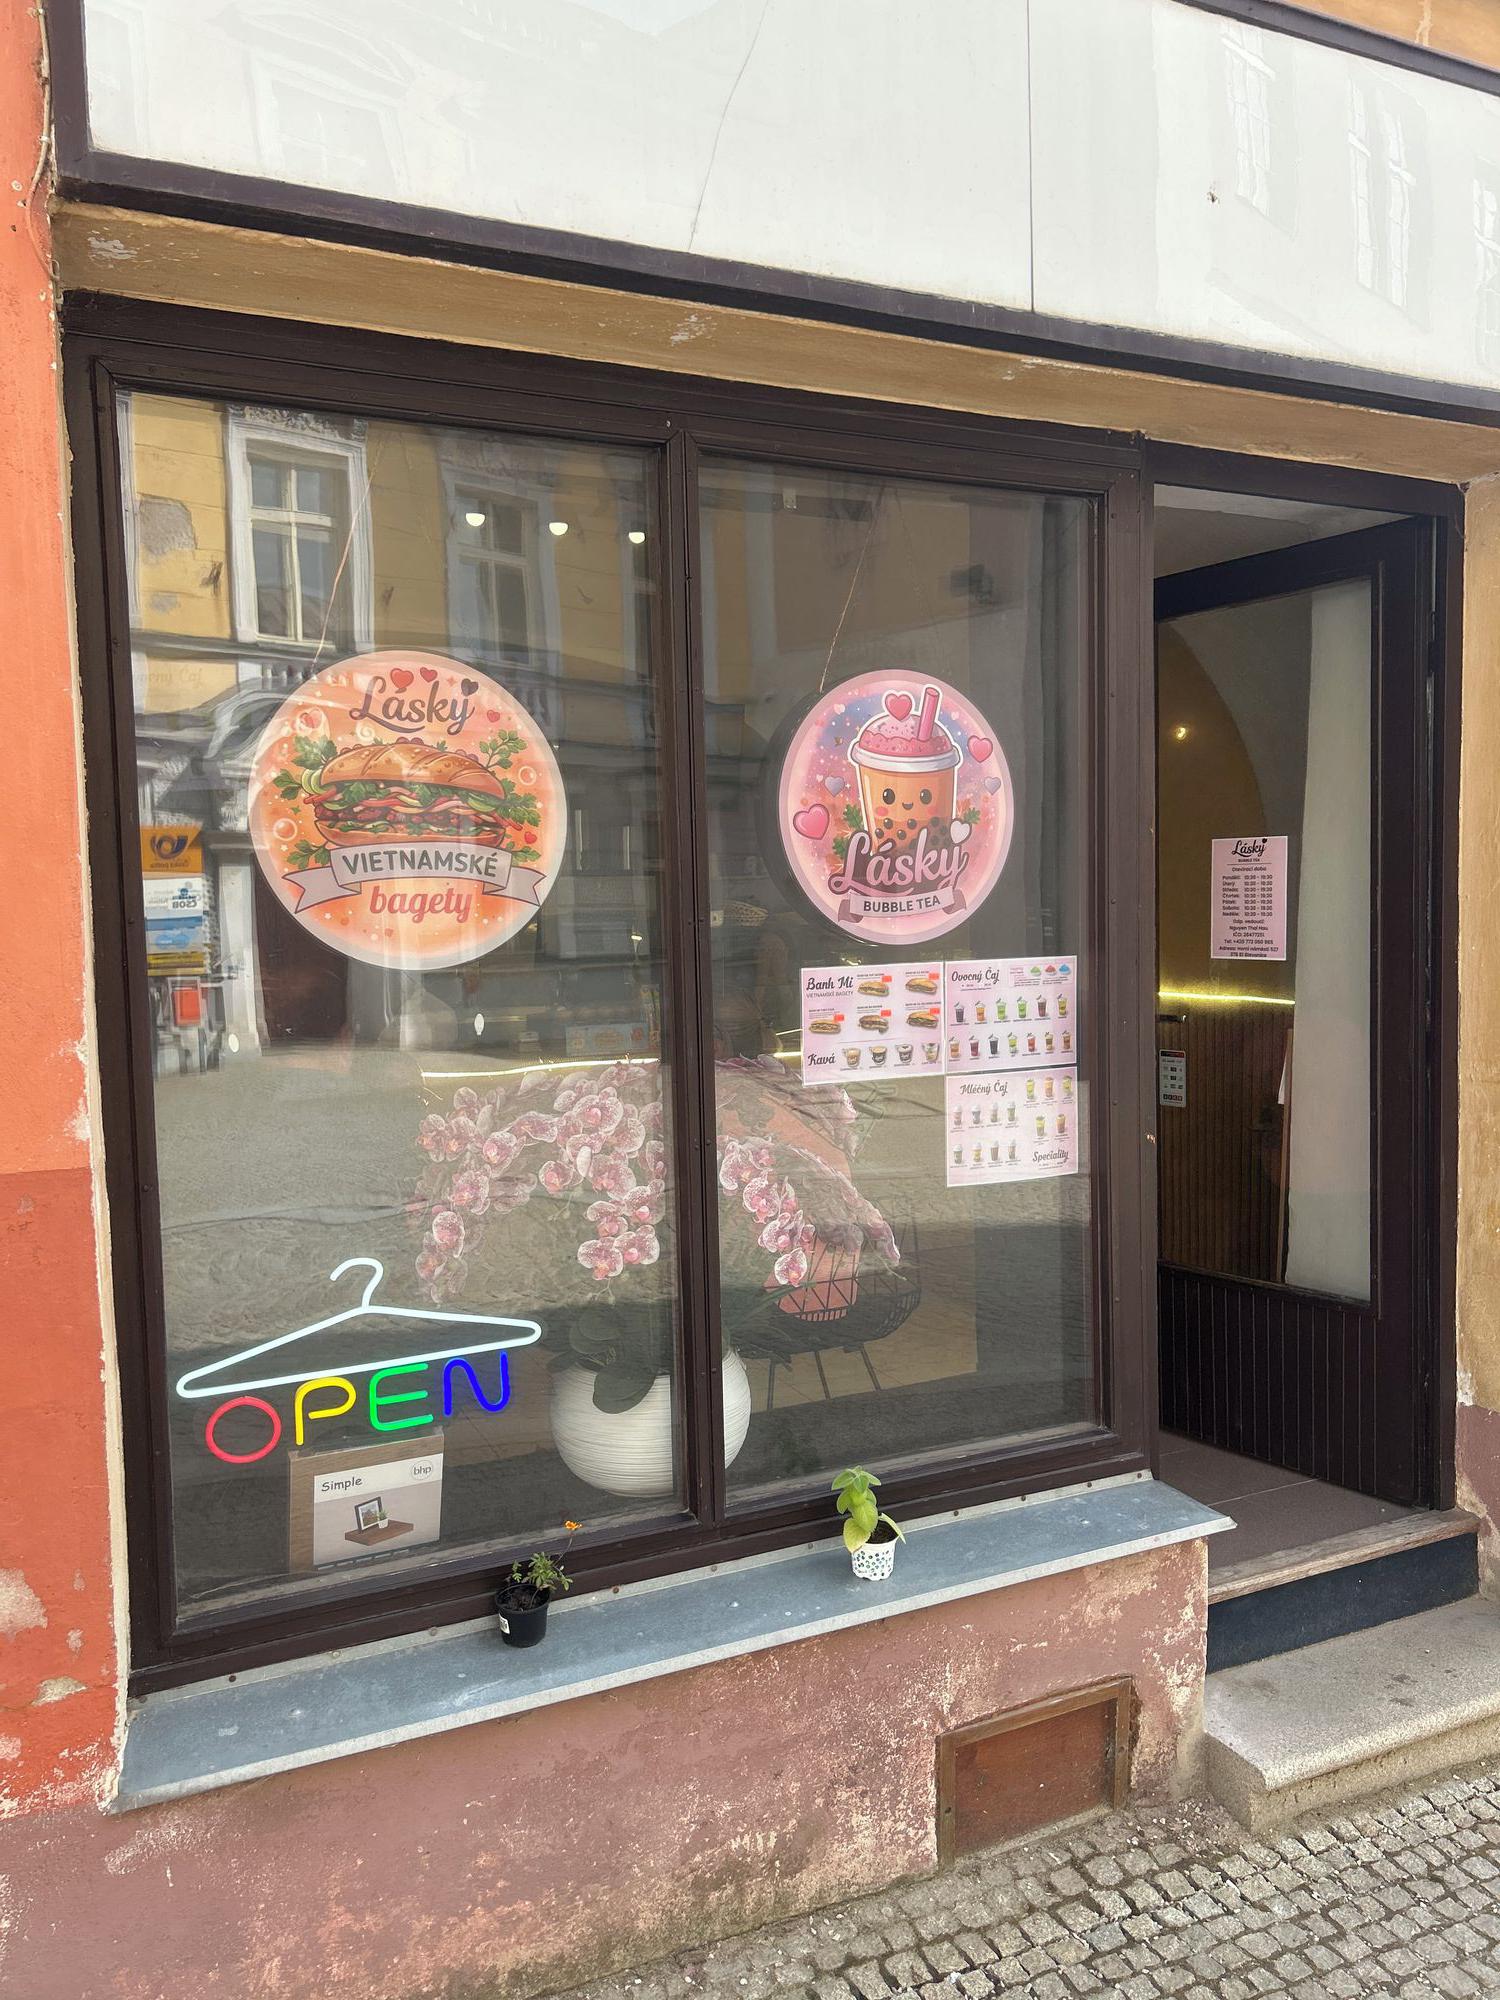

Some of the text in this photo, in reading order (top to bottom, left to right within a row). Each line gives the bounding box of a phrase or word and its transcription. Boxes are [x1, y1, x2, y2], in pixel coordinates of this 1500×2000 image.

[349, 676, 476, 736] Lásky
[1231, 839, 1266, 857] Lásky
[342, 849, 498, 878] VIETNAMSKÉ
[829, 827, 968, 897] Lásky
[369, 885, 473, 923] bagety
[863, 895, 941, 913] BUBBLE TEA
[806, 977, 836, 991] Banh
[837, 976, 854, 988] Mi
[951, 970, 983, 983] Ovocný
[985, 967, 1000, 985] Čaj
[807, 1052, 836, 1066] Kavá
[960, 1080, 1008, 1096] Mléčný Čaj
[1032, 1149, 1070, 1163] Speciality
[205, 1350, 511, 1464] OPEN
[413, 1463, 432, 1476] bhp
[321, 1476, 363, 1492] Simple
